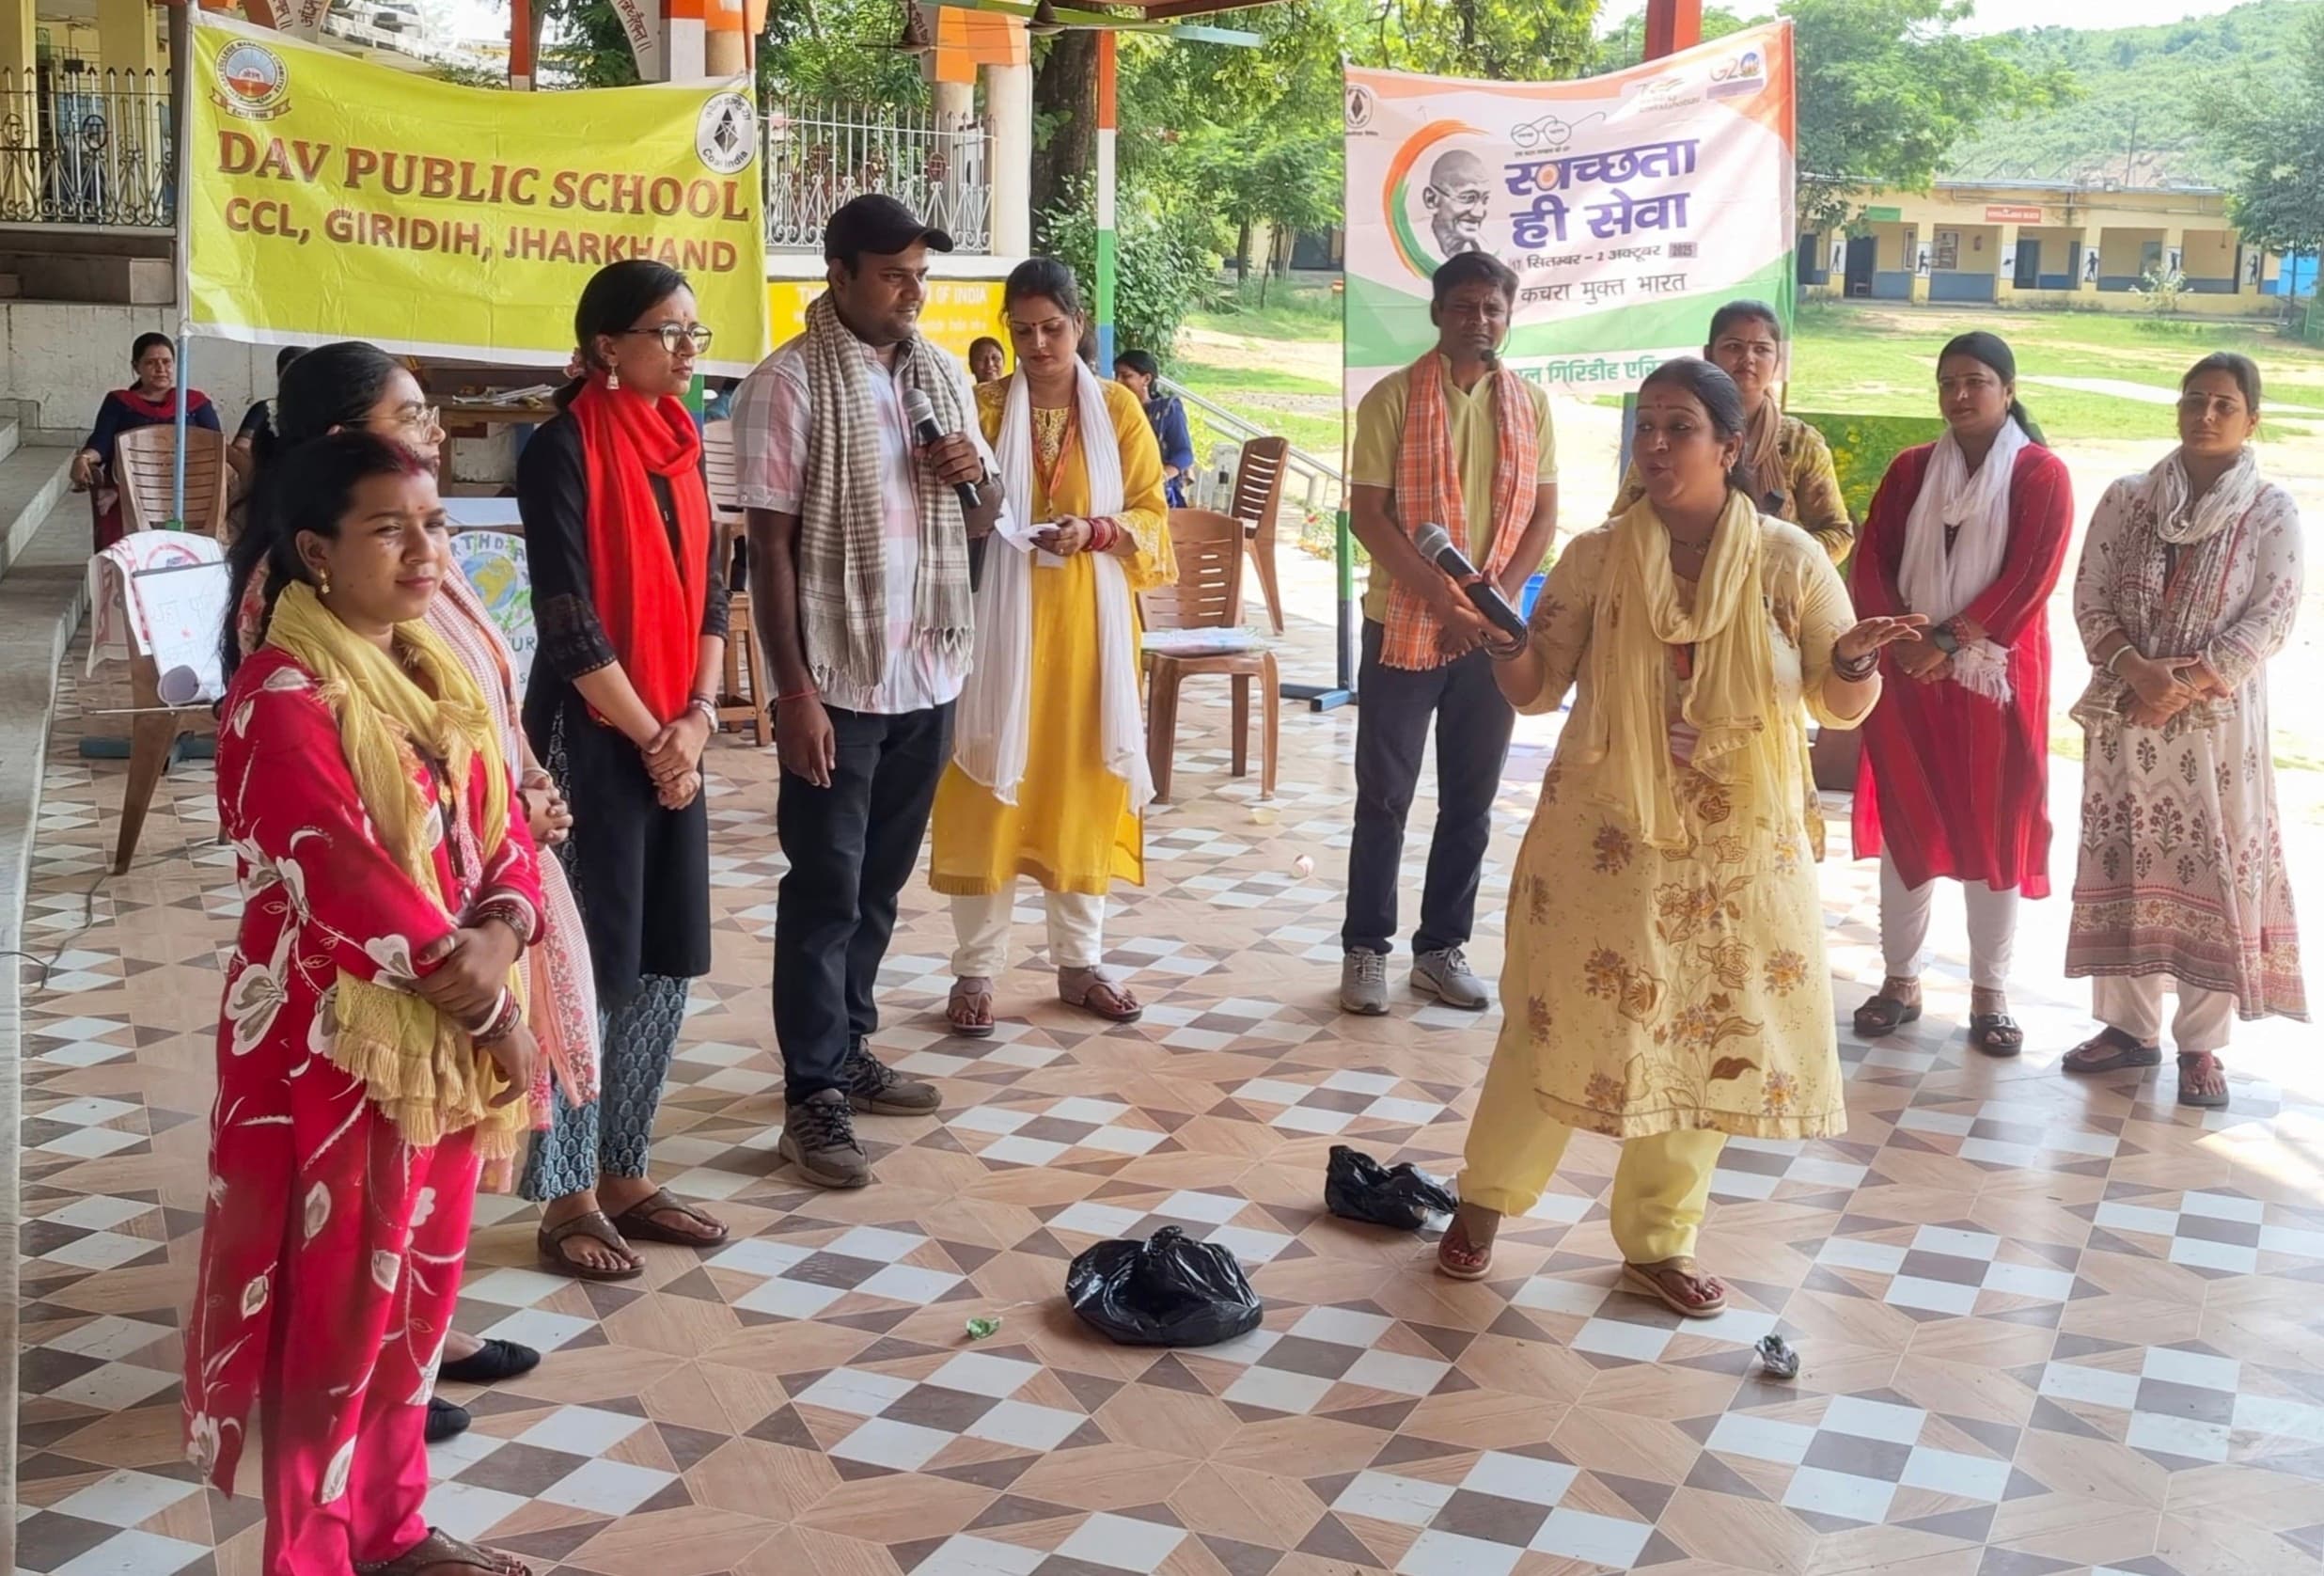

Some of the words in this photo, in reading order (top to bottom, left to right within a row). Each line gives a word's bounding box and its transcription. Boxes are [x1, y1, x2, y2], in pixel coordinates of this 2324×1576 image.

[218, 130, 331, 182] DAV
[344, 147, 541, 205] PUBLIC
[549, 170, 749, 222] SCHOOL
[1504, 139, 1700, 196] स्वच्छता
[225, 197, 310, 244] CCL,
[324, 209, 493, 262] GIRIDIH,
[504, 226, 738, 273] JHARKHAND
[1510, 194, 1570, 249] ही
[1583, 188, 1690, 239] सेवा
[954, 286, 986, 305] INDIA
[1520, 283, 1572, 303] कचरा
[1580, 278, 1627, 305] मुक्त
[1637, 273, 1688, 292] भारत
[1547, 358, 1619, 384] गिरिडीह
